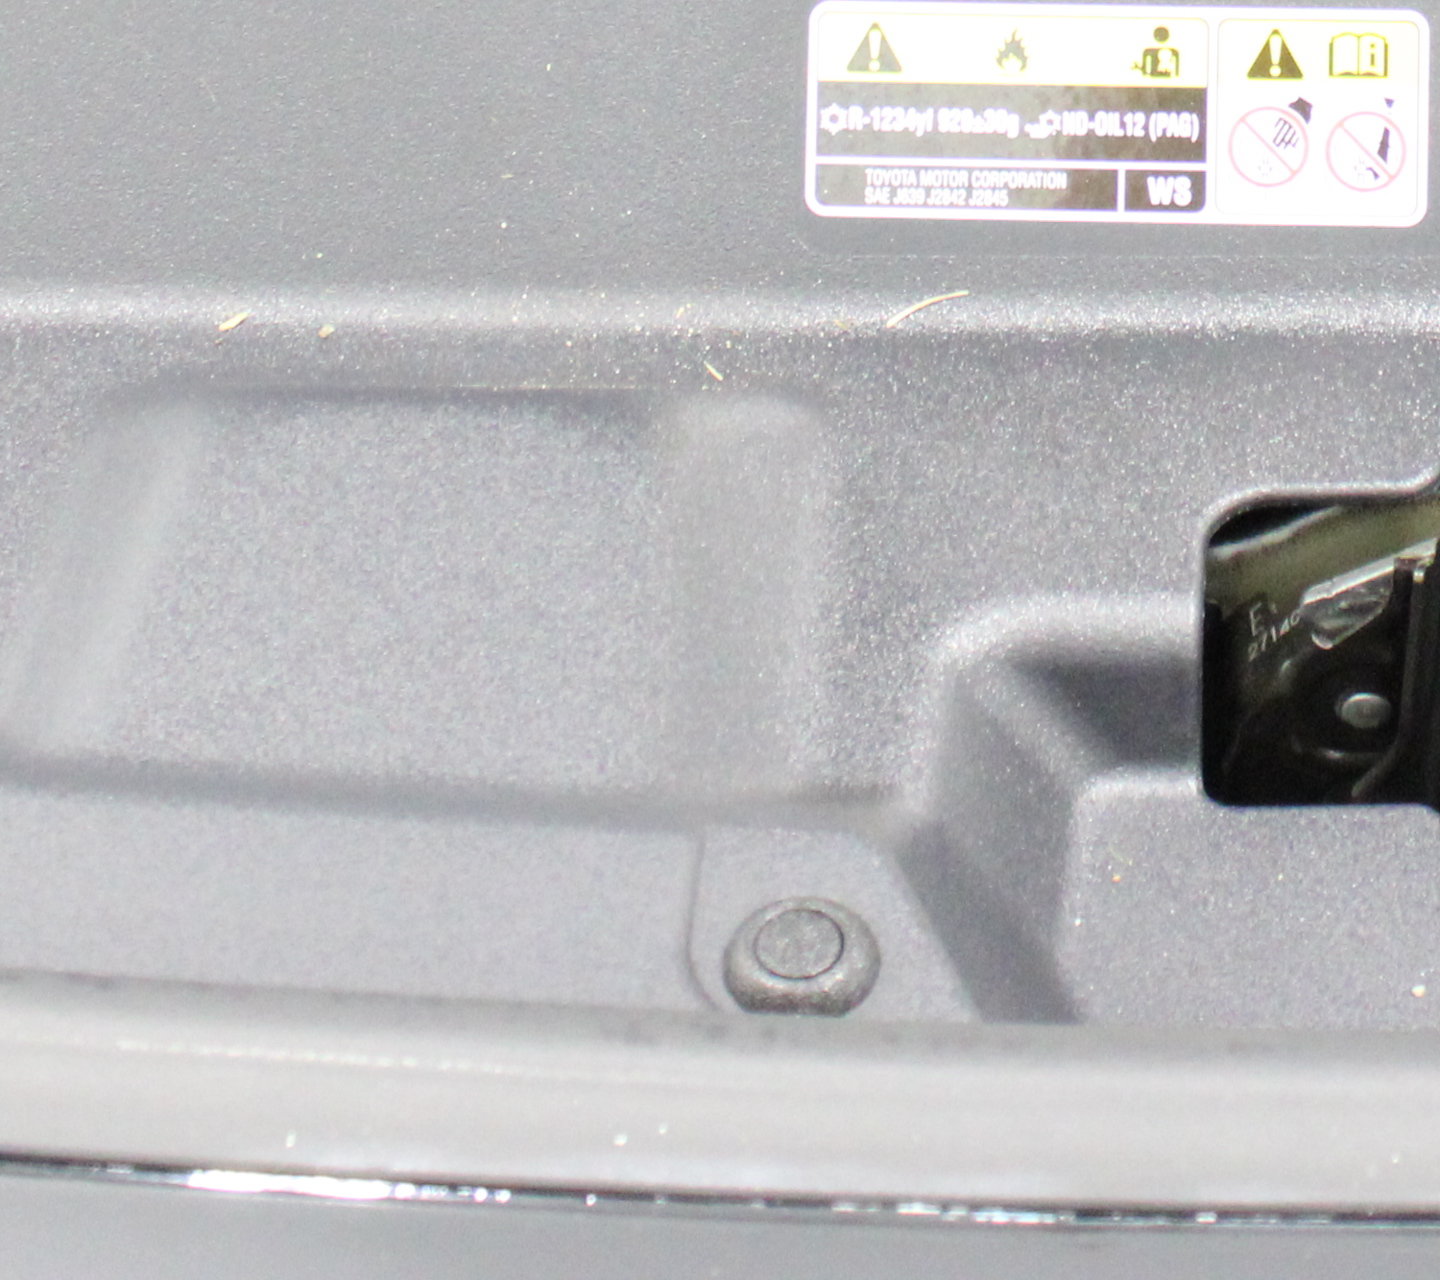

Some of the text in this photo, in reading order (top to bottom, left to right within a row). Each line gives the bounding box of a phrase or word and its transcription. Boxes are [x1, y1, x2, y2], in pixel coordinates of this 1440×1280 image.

[1149, 112, 1199, 142] (PAG)
[865, 168, 1066, 190] TOYOTA MOTOR CORPORATION
[1147, 176, 1193, 206] WS
[865, 187, 890, 204] SAE
